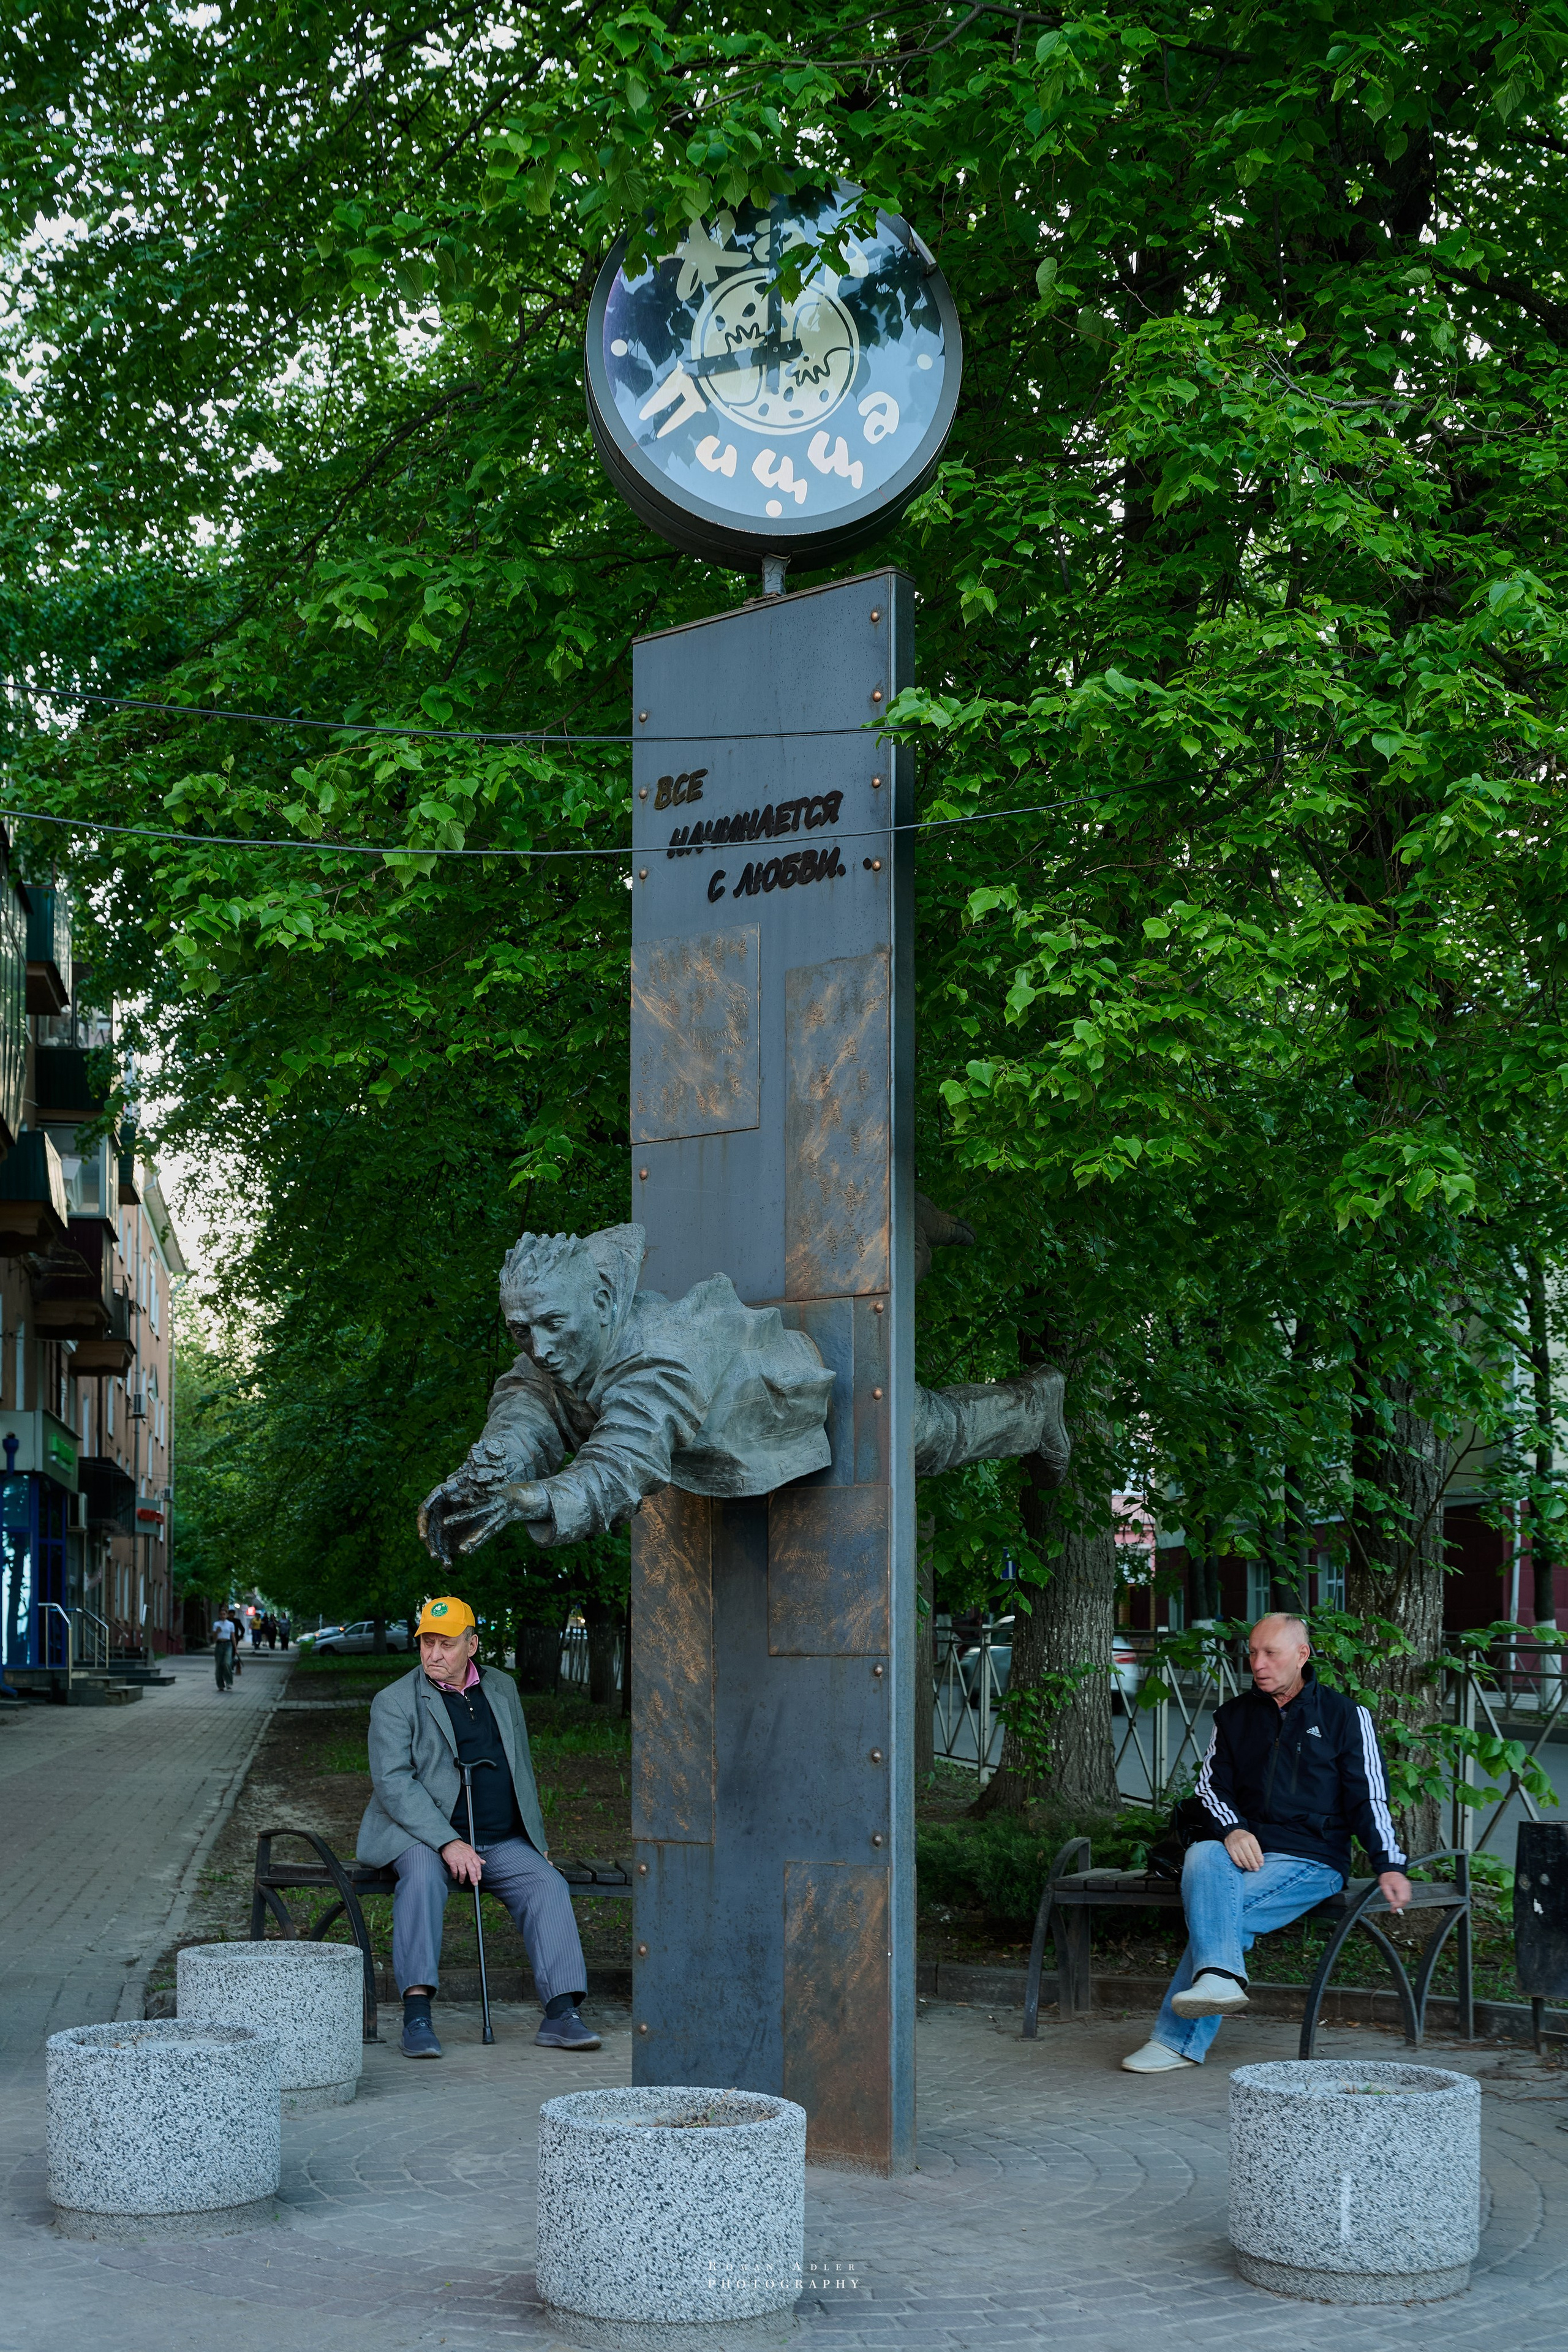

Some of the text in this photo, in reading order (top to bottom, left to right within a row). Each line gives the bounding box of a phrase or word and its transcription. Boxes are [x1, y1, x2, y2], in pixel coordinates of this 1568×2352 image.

[639, 360, 900, 505] Пицца
[654, 768, 708, 810] ВСЕ
[666, 790, 843, 858] НАЧИНАЕТСЯ
[707, 869, 726, 902] С
